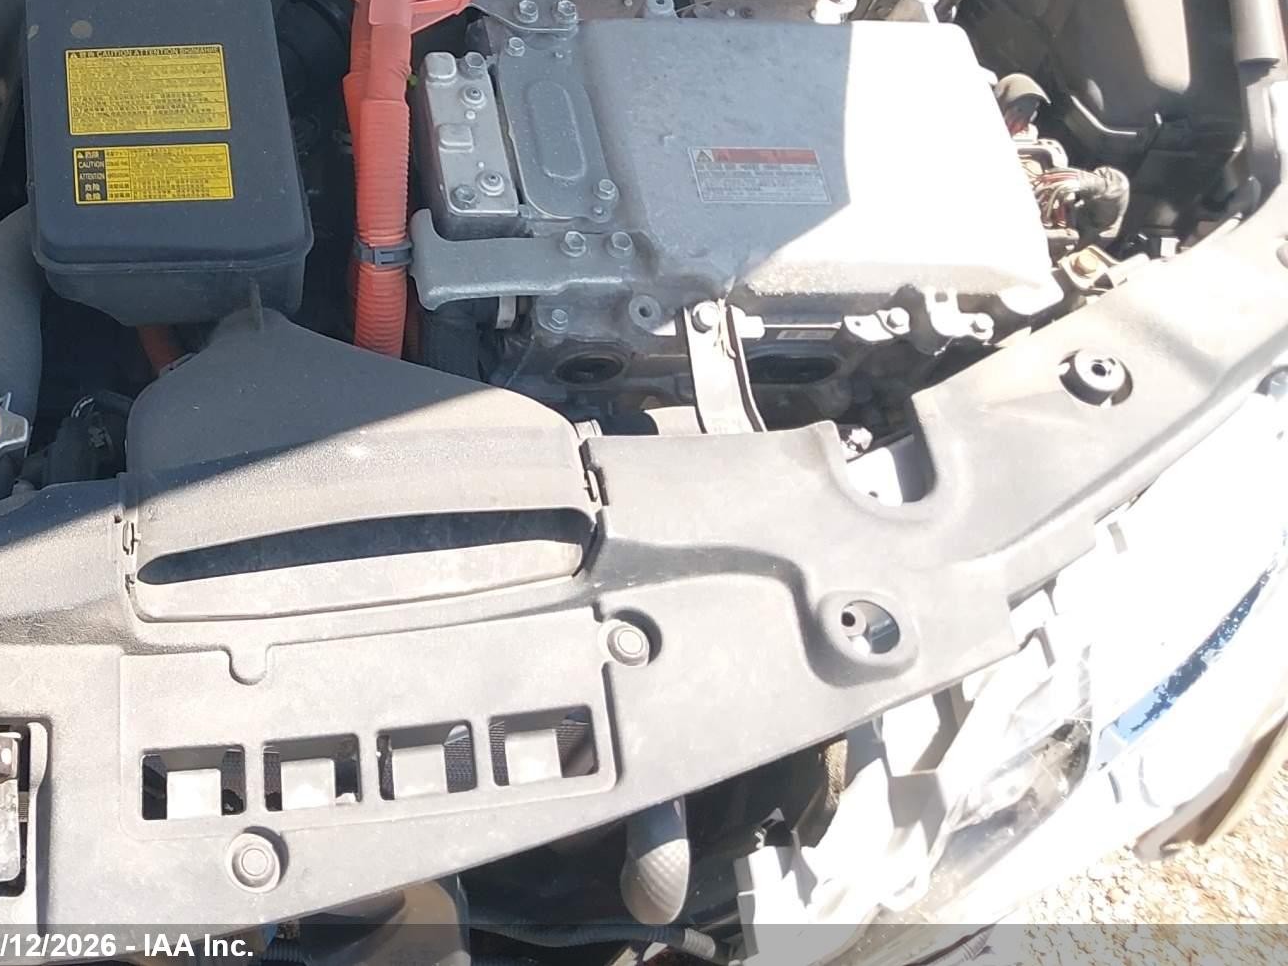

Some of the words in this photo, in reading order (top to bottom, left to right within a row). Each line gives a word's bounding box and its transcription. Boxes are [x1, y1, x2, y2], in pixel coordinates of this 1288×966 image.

[96, 49, 133, 58] CAUTION
[134, 48, 179, 57] ATTENTION
[78, 160, 105, 169] CAUTION
[79, 172, 105, 181] ATTENTION
